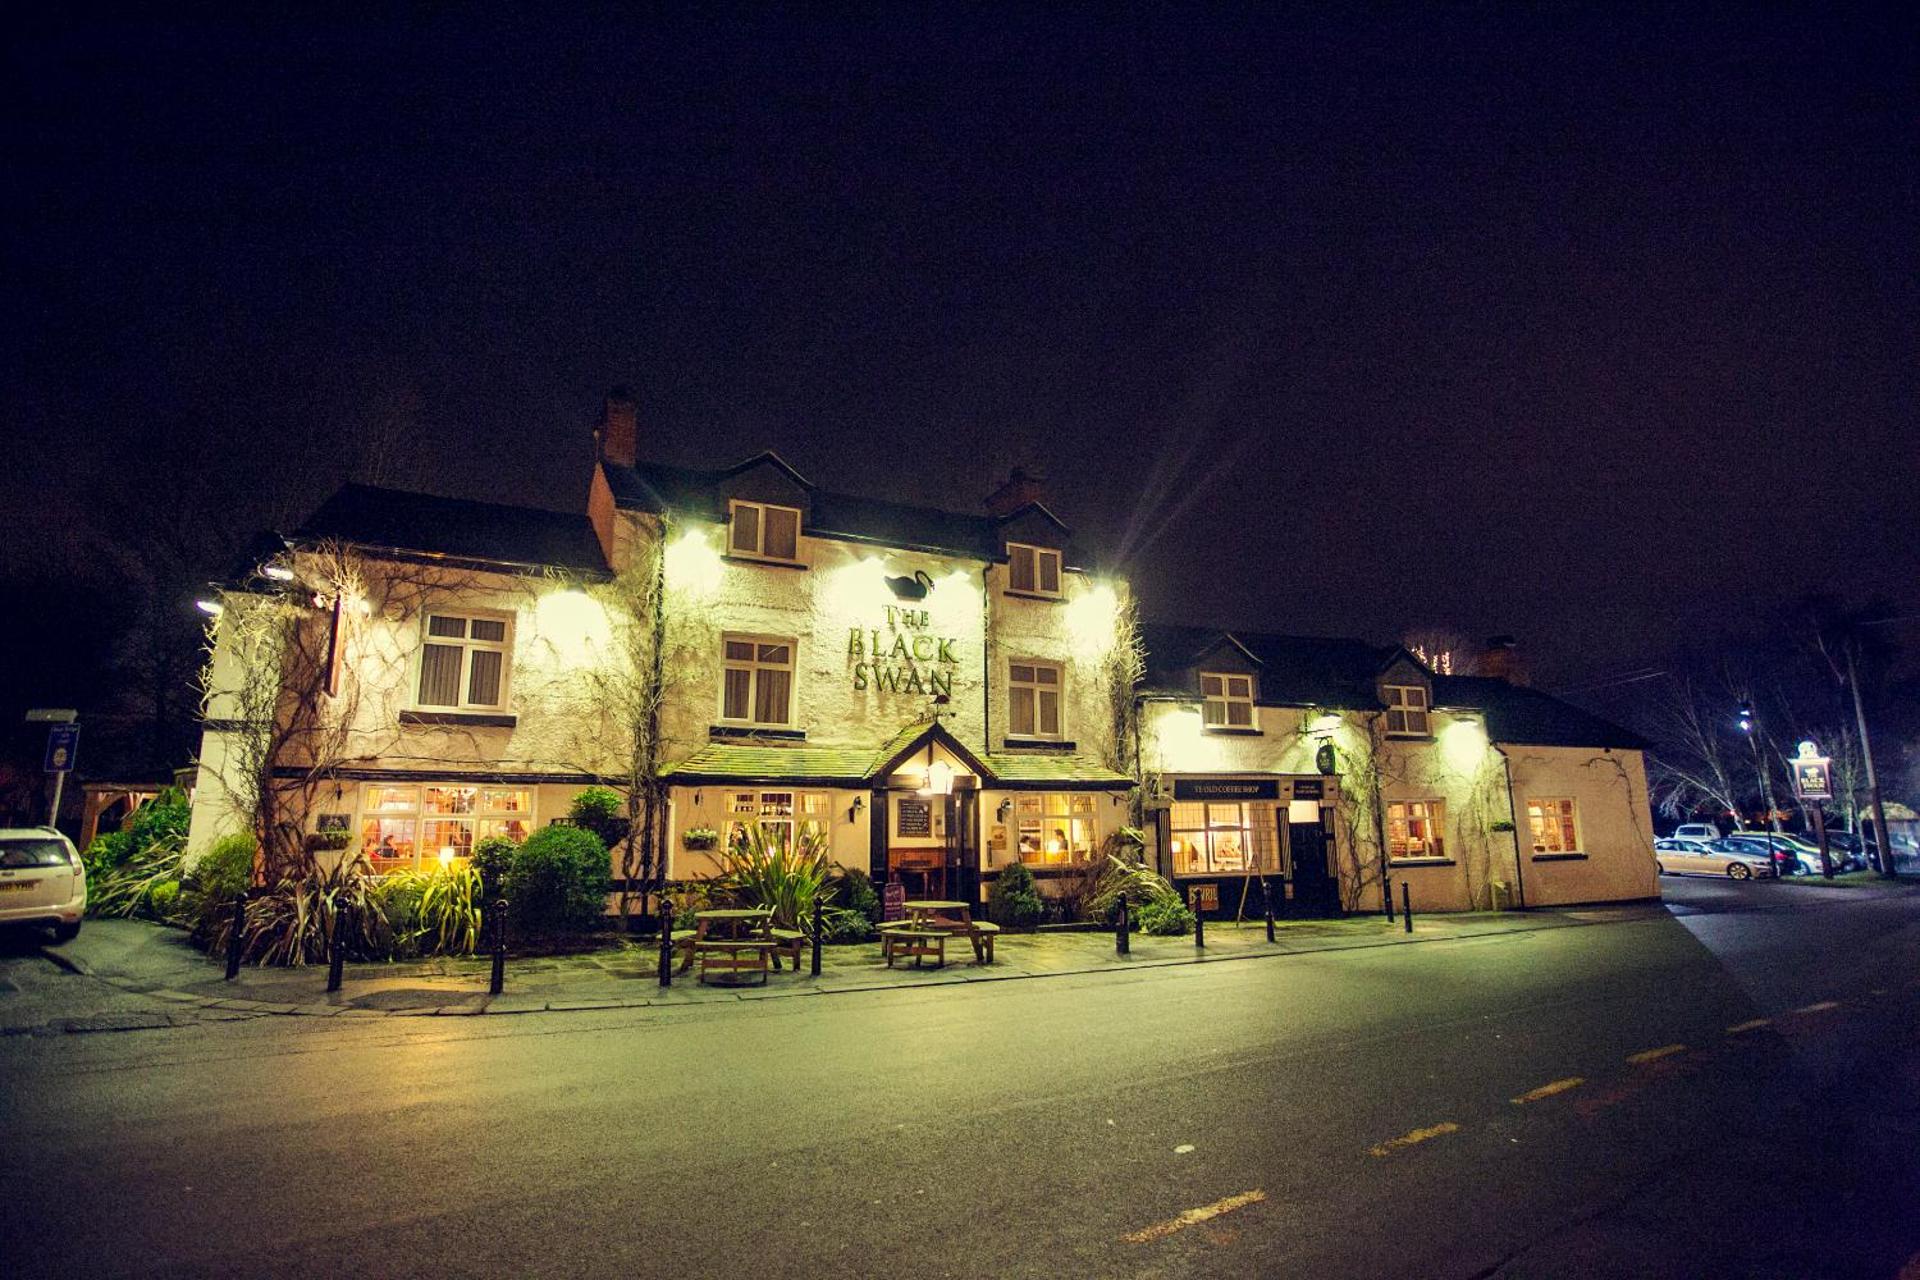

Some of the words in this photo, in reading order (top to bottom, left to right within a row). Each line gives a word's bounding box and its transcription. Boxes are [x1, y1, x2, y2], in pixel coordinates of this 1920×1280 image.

[882, 604, 929, 627] THE
[849, 627, 960, 664] BLACK
[854, 661, 952, 697] SWAN
